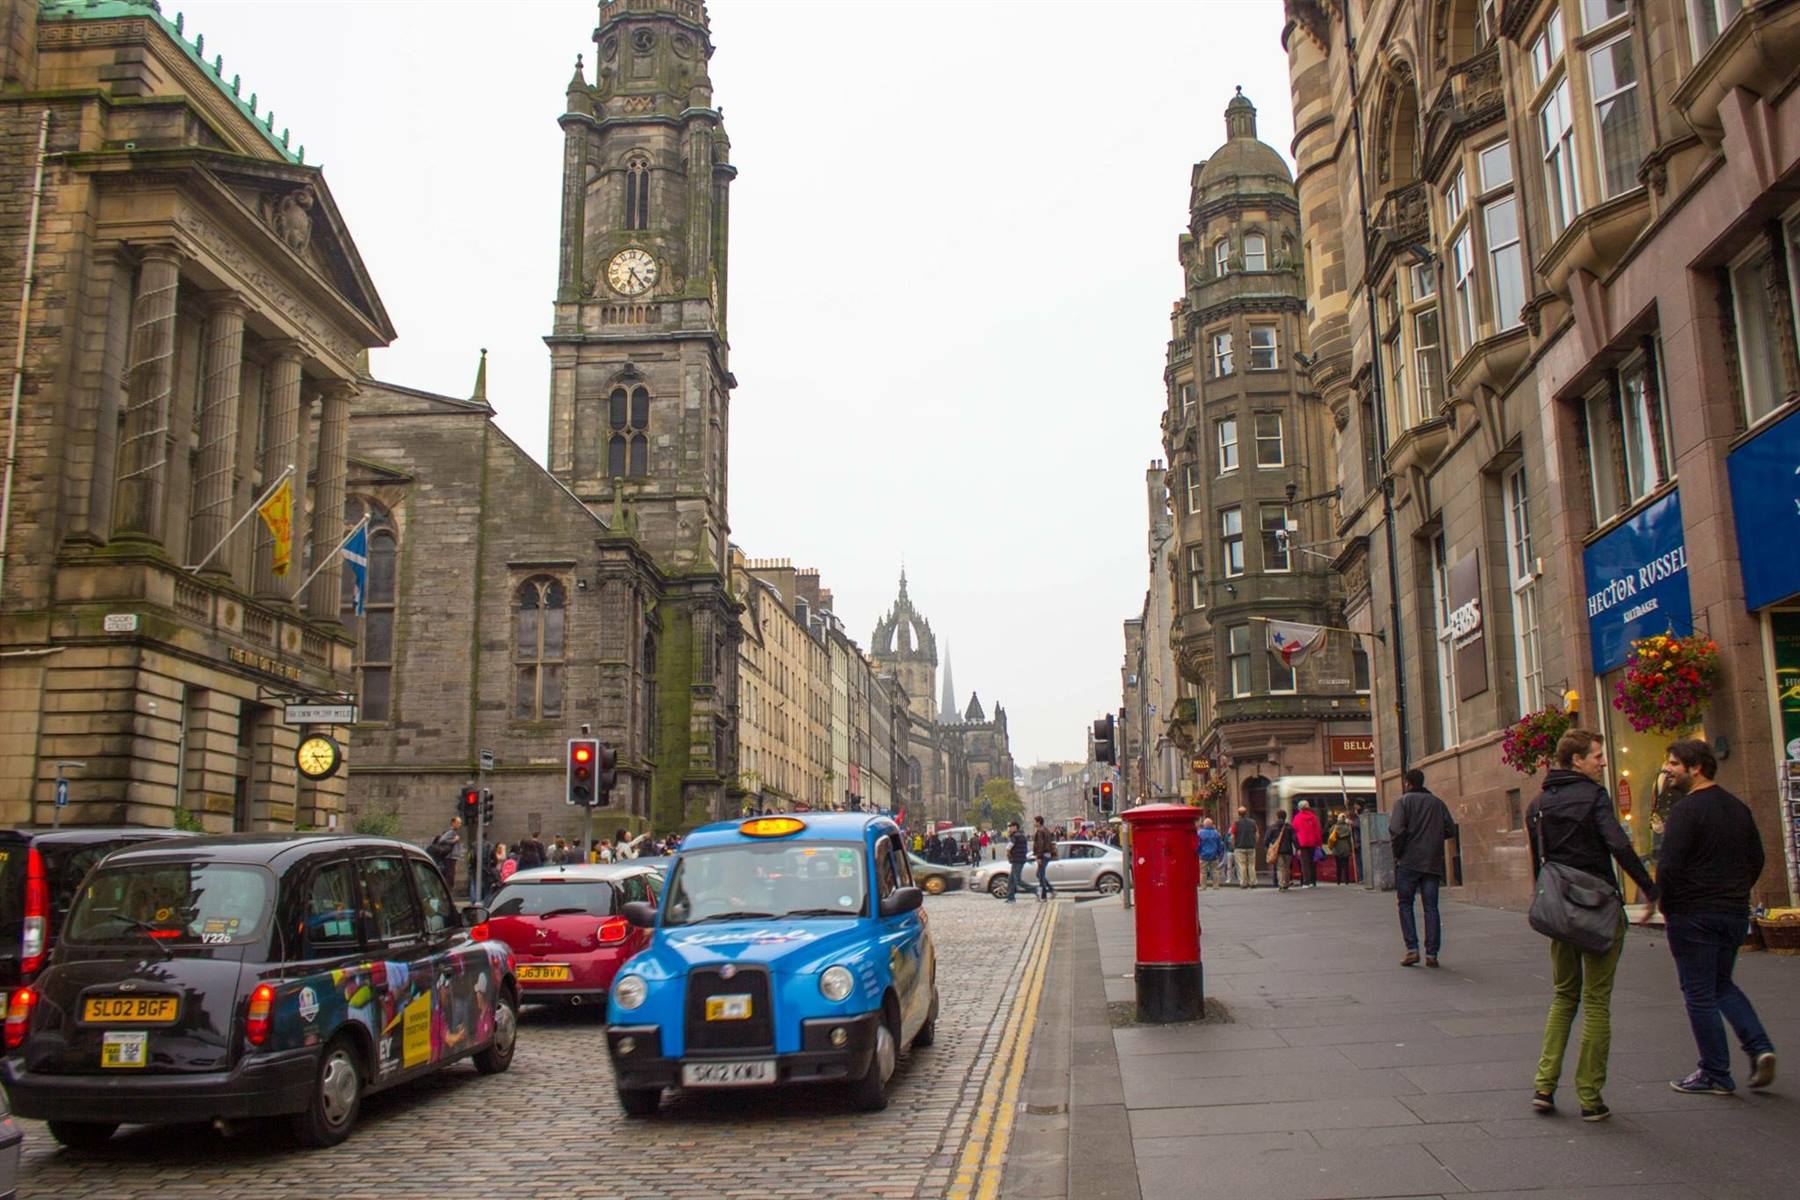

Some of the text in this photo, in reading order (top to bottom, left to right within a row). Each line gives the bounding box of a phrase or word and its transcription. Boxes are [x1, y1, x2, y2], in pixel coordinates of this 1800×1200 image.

[1588, 575, 1637, 617] HECTOR
[1343, 741, 1375, 751] BELLA
[92, 999, 170, 1017] SL02 BGF
